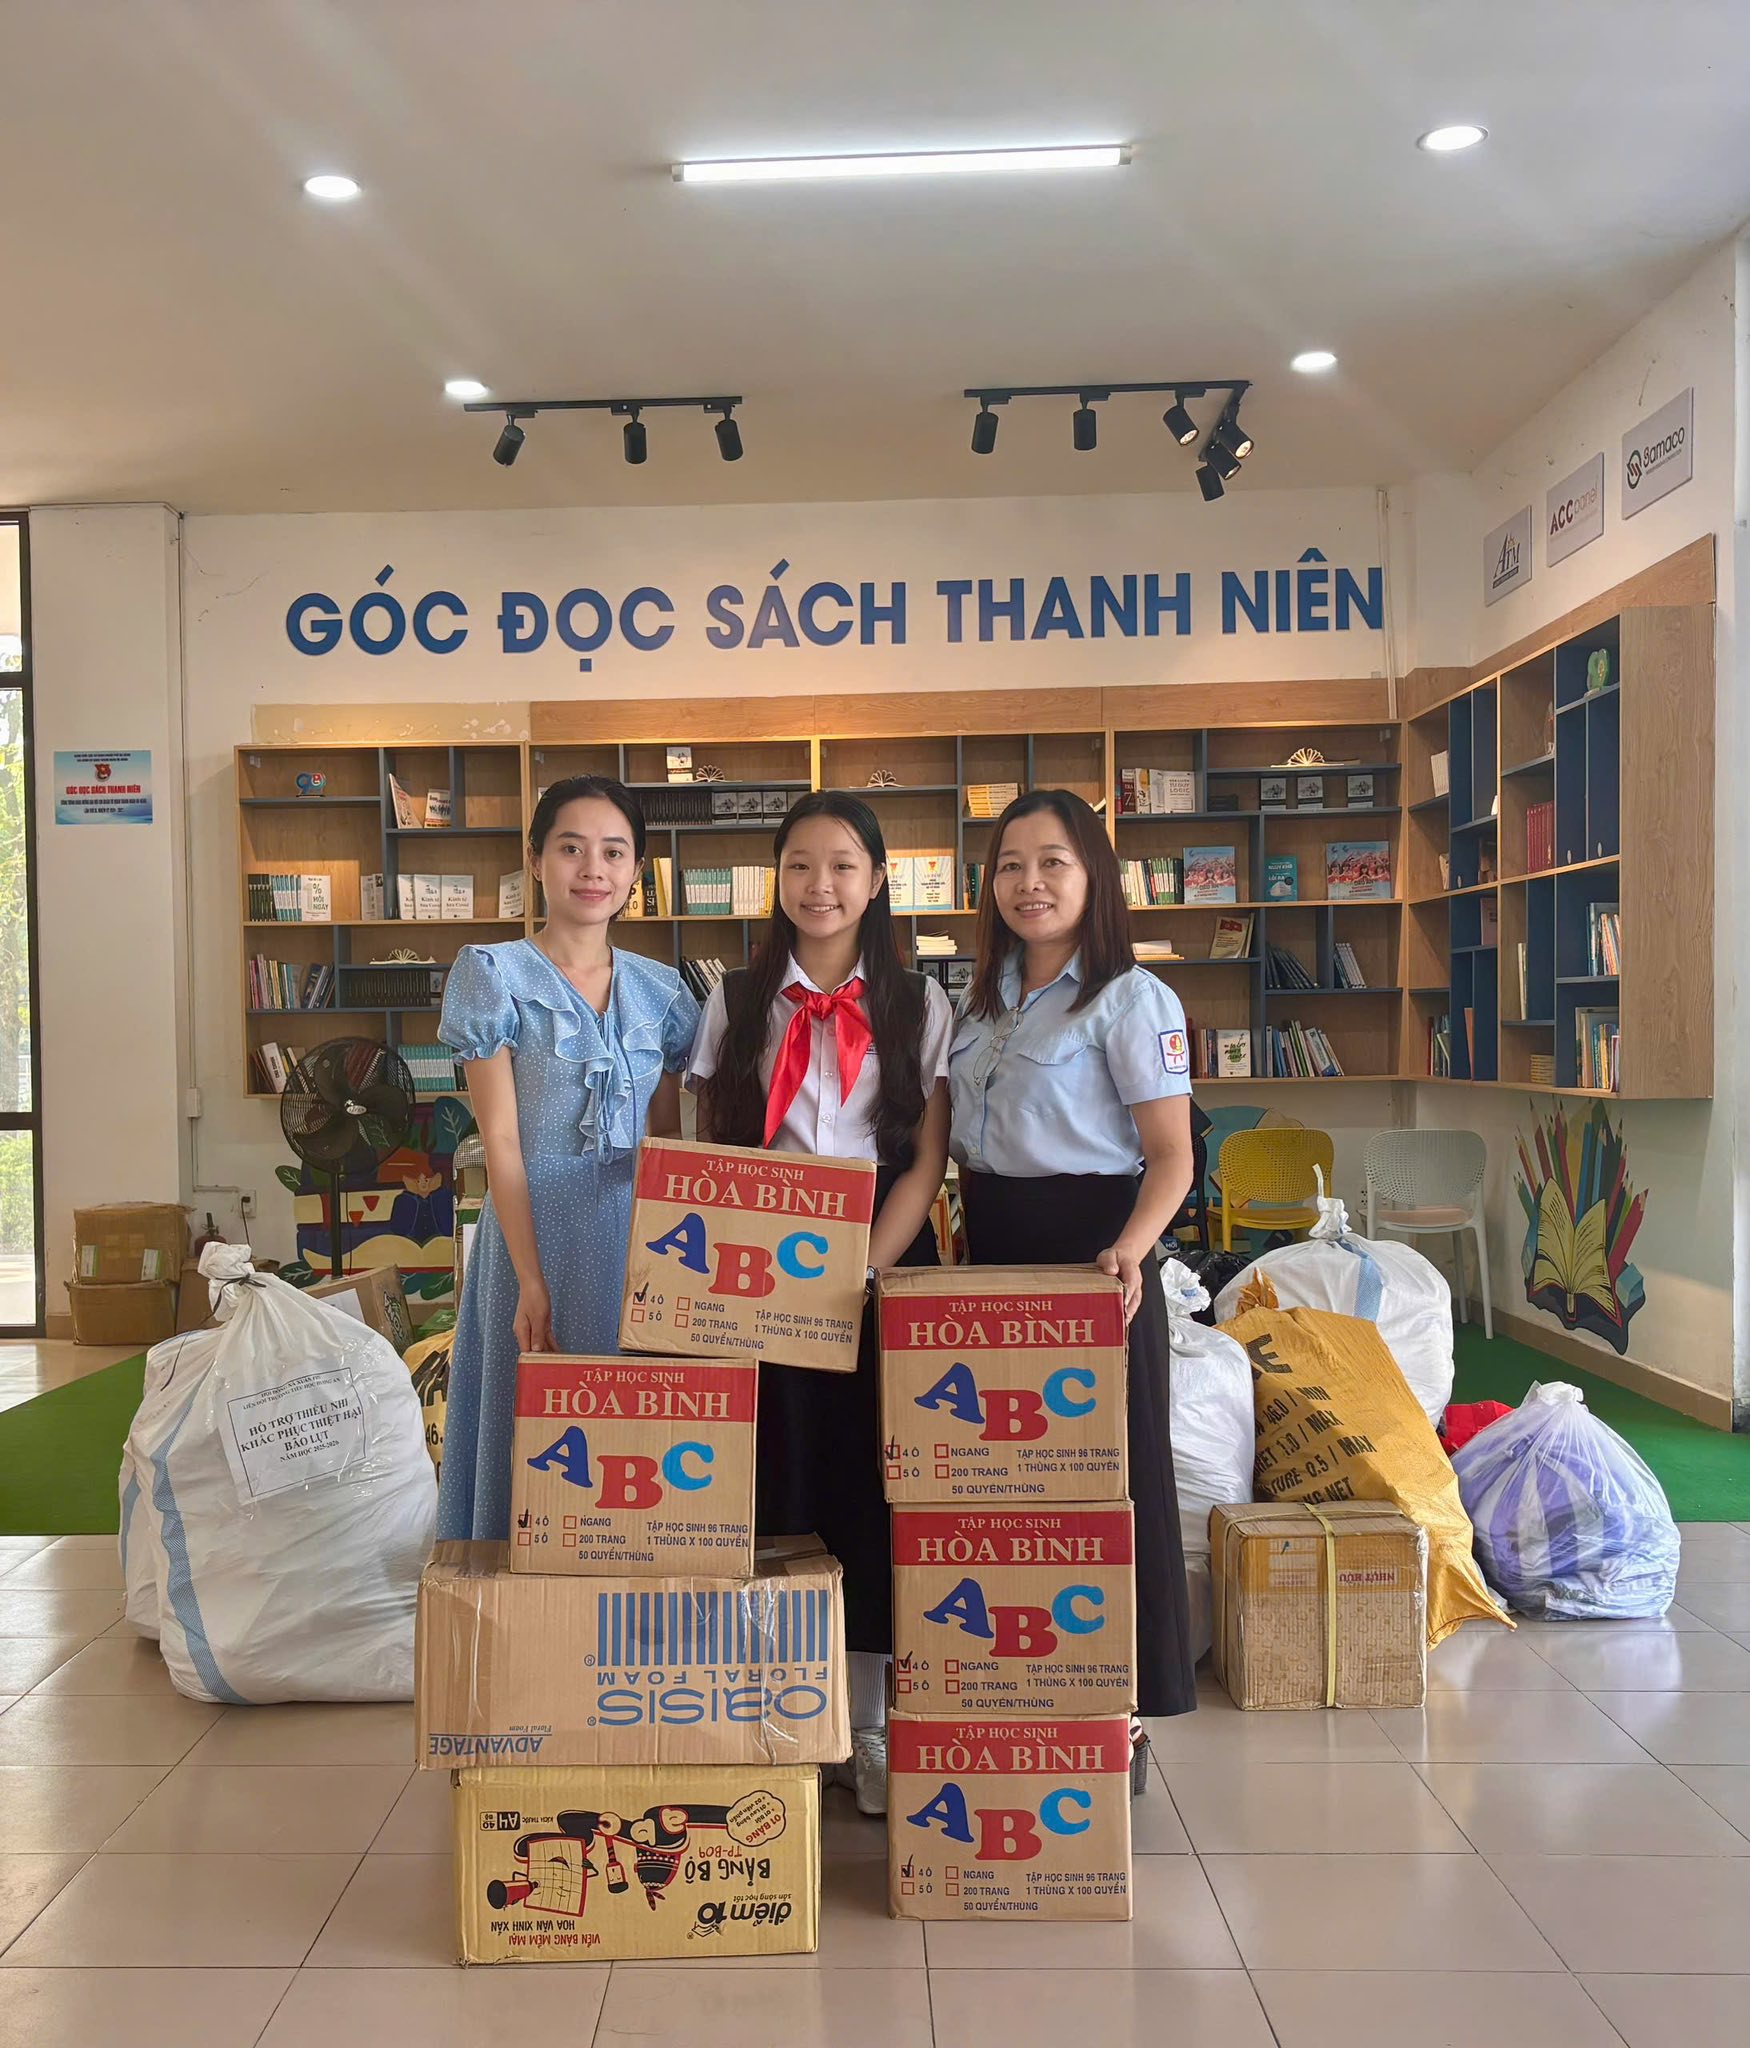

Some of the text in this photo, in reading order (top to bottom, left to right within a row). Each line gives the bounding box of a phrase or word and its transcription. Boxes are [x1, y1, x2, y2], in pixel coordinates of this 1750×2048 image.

[285, 547, 1384, 673] GÓC ĐỌC SÁCH THANH NIÊN
[707, 1159, 804, 1179] TẬP HỌC SINH
[664, 1170, 847, 1218] HÒA BÌNH
[646, 1212, 829, 1298] ABC
[658, 1294, 664, 1304] Ô
[695, 1301, 725, 1312] NGANG
[949, 1300, 1052, 1313] TẬP HỌC SINH
[649, 1310, 662, 1321] 5 Ô
[692, 1318, 738, 1330] 200 TRANG
[756, 1311, 853, 1329] TẬP HỌC SINH 96 TRANG
[755, 1324, 852, 1343] 1 THÙNG X 100 QUYỂN
[908, 1313, 1094, 1346] HÒA BÌNH
[691, 1332, 764, 1349] 50 QUYỂN/THÙNG
[584, 1369, 685, 1384] TẬP HỌC SINH
[543, 1381, 730, 1418] HÒA BÌNH
[914, 1362, 1096, 1441] ABC
[284, 1430, 330, 1452] BÃO LỤT
[1306, 1454, 1329, 1478] 0.5
[1328, 1445, 1339, 1464] /
[1337, 1435, 1377, 1457] MAX
[527, 1426, 714, 1509] ABC
[1324, 1477, 1355, 1501] NET
[958, 1517, 1061, 1532] TẬP HỌC SINH
[918, 1530, 1104, 1562] HÒA BÌNH
[923, 1578, 1104, 1657] ABC
[597, 1667, 828, 1686] FLORAL FOAM
[509, 1725, 552, 1733] Floral Foam
[956, 1726, 1057, 1741] TẬP HỌC SINH
[429, 1737, 543, 1755] ADVANTAGE
[917, 1739, 1104, 1771] HÒA BÌNH
[500, 1813, 518, 1830] A4
[745, 1814, 781, 1843] 01 BẢNG
[906, 1782, 1092, 1861] ABC
[699, 1845, 742, 1858] TP-B09
[685, 1856, 770, 1886] BẢNG BỘ
[964, 1871, 994, 1879] NGANG
[1026, 1872, 1126, 1883] TẬP HỌC SINH 96 TRANG
[964, 1887, 1010, 1895] 200 TRANG
[1027, 1887, 1031, 1895] 1
[1034, 1884, 1065, 1895] THÙNG
[1077, 1886, 1092, 1894] 100
[1094, 1883, 1126, 1894] QUYỂN
[976, 1899, 1038, 1911] QUYỂN/THÙNG
